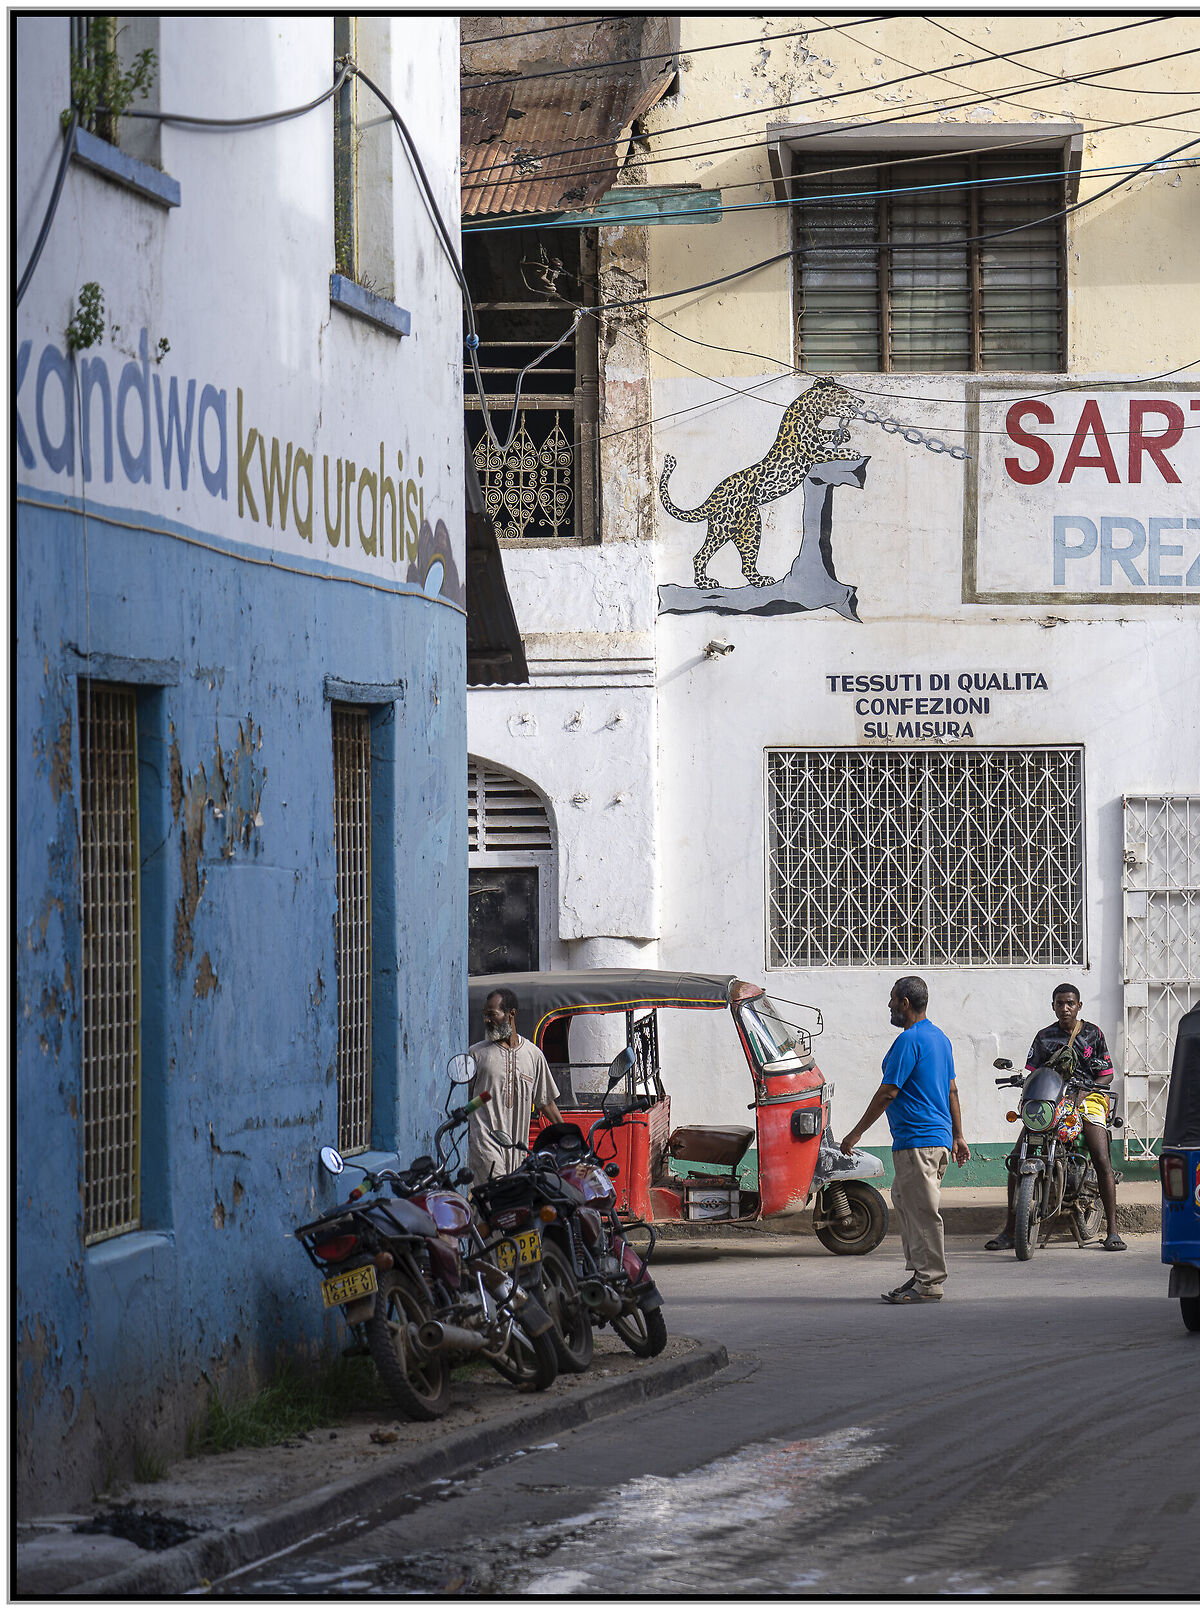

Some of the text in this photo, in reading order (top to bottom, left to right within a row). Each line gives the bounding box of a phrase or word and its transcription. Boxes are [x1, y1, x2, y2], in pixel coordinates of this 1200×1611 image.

[237, 387, 424, 563] kwa urahisi
[826, 672, 1049, 693] TESSUTI DI QUALITA
[855, 697, 991, 716] CONFEZIONI
[863, 721, 974, 739] SU MISURA
